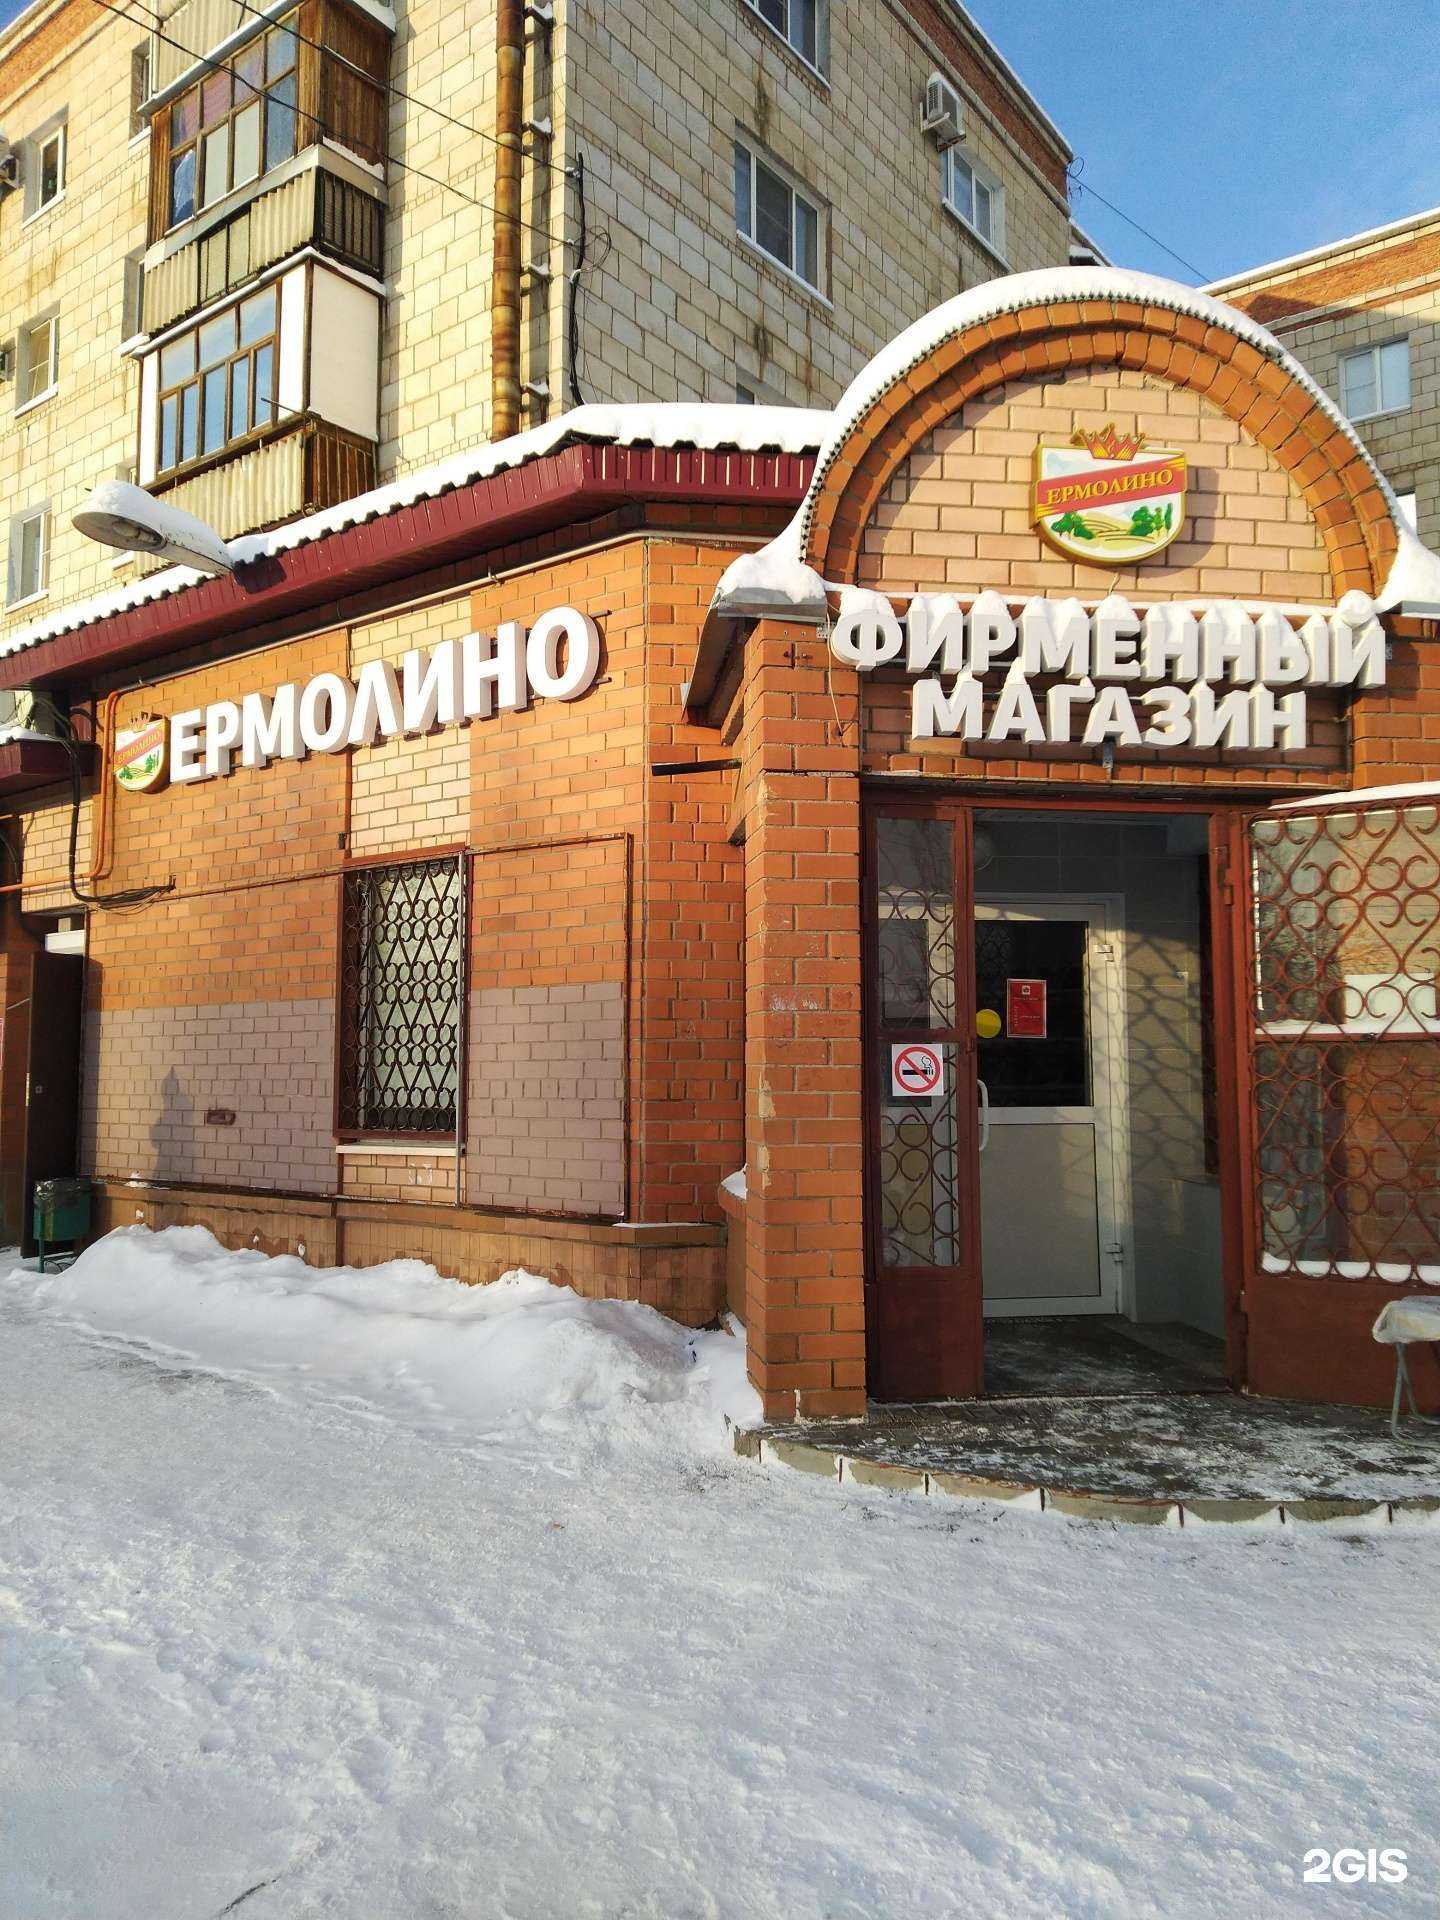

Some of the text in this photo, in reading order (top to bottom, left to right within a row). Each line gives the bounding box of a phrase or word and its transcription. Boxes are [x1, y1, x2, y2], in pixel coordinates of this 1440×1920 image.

[1046, 468, 1174, 505] ЕРМОЛИНО
[830, 601, 1386, 688] ФИРМЕННЫЙ
[169, 605, 600, 784] ЕРМОЛИНО
[911, 676, 1306, 751] МАГАЗИН
